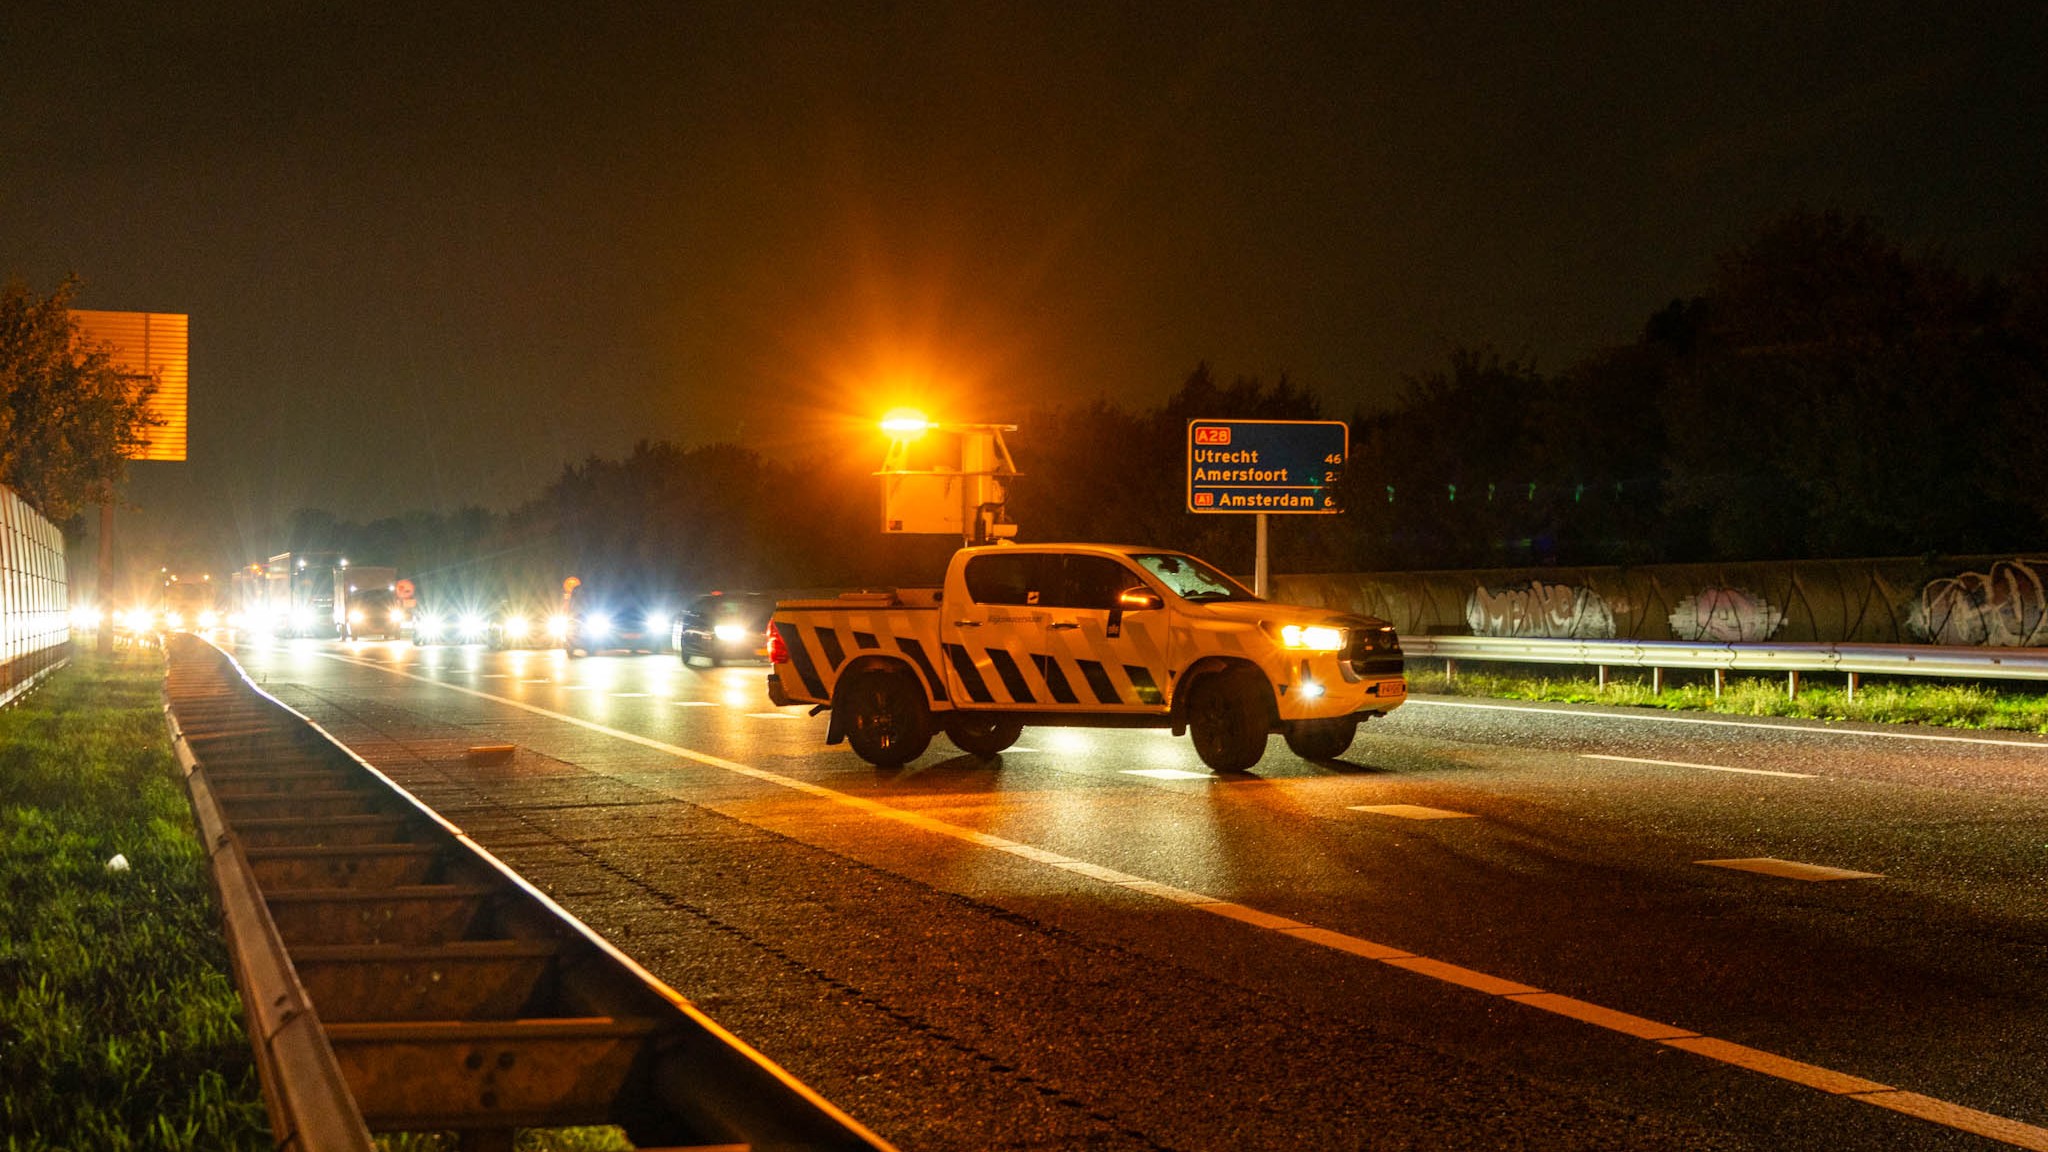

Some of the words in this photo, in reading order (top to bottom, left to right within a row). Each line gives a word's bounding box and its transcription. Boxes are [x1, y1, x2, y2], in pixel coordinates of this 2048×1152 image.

[1198, 430, 1228, 442] A28
[1194, 450, 1259, 464] Utrecht
[1324, 453, 1342, 465] 46
[1194, 467, 1288, 482] Amersfoort
[1198, 495, 1211, 505] A1
[1219, 493, 1314, 507] Amsterdam
[1323, 496, 1336, 507] 6
